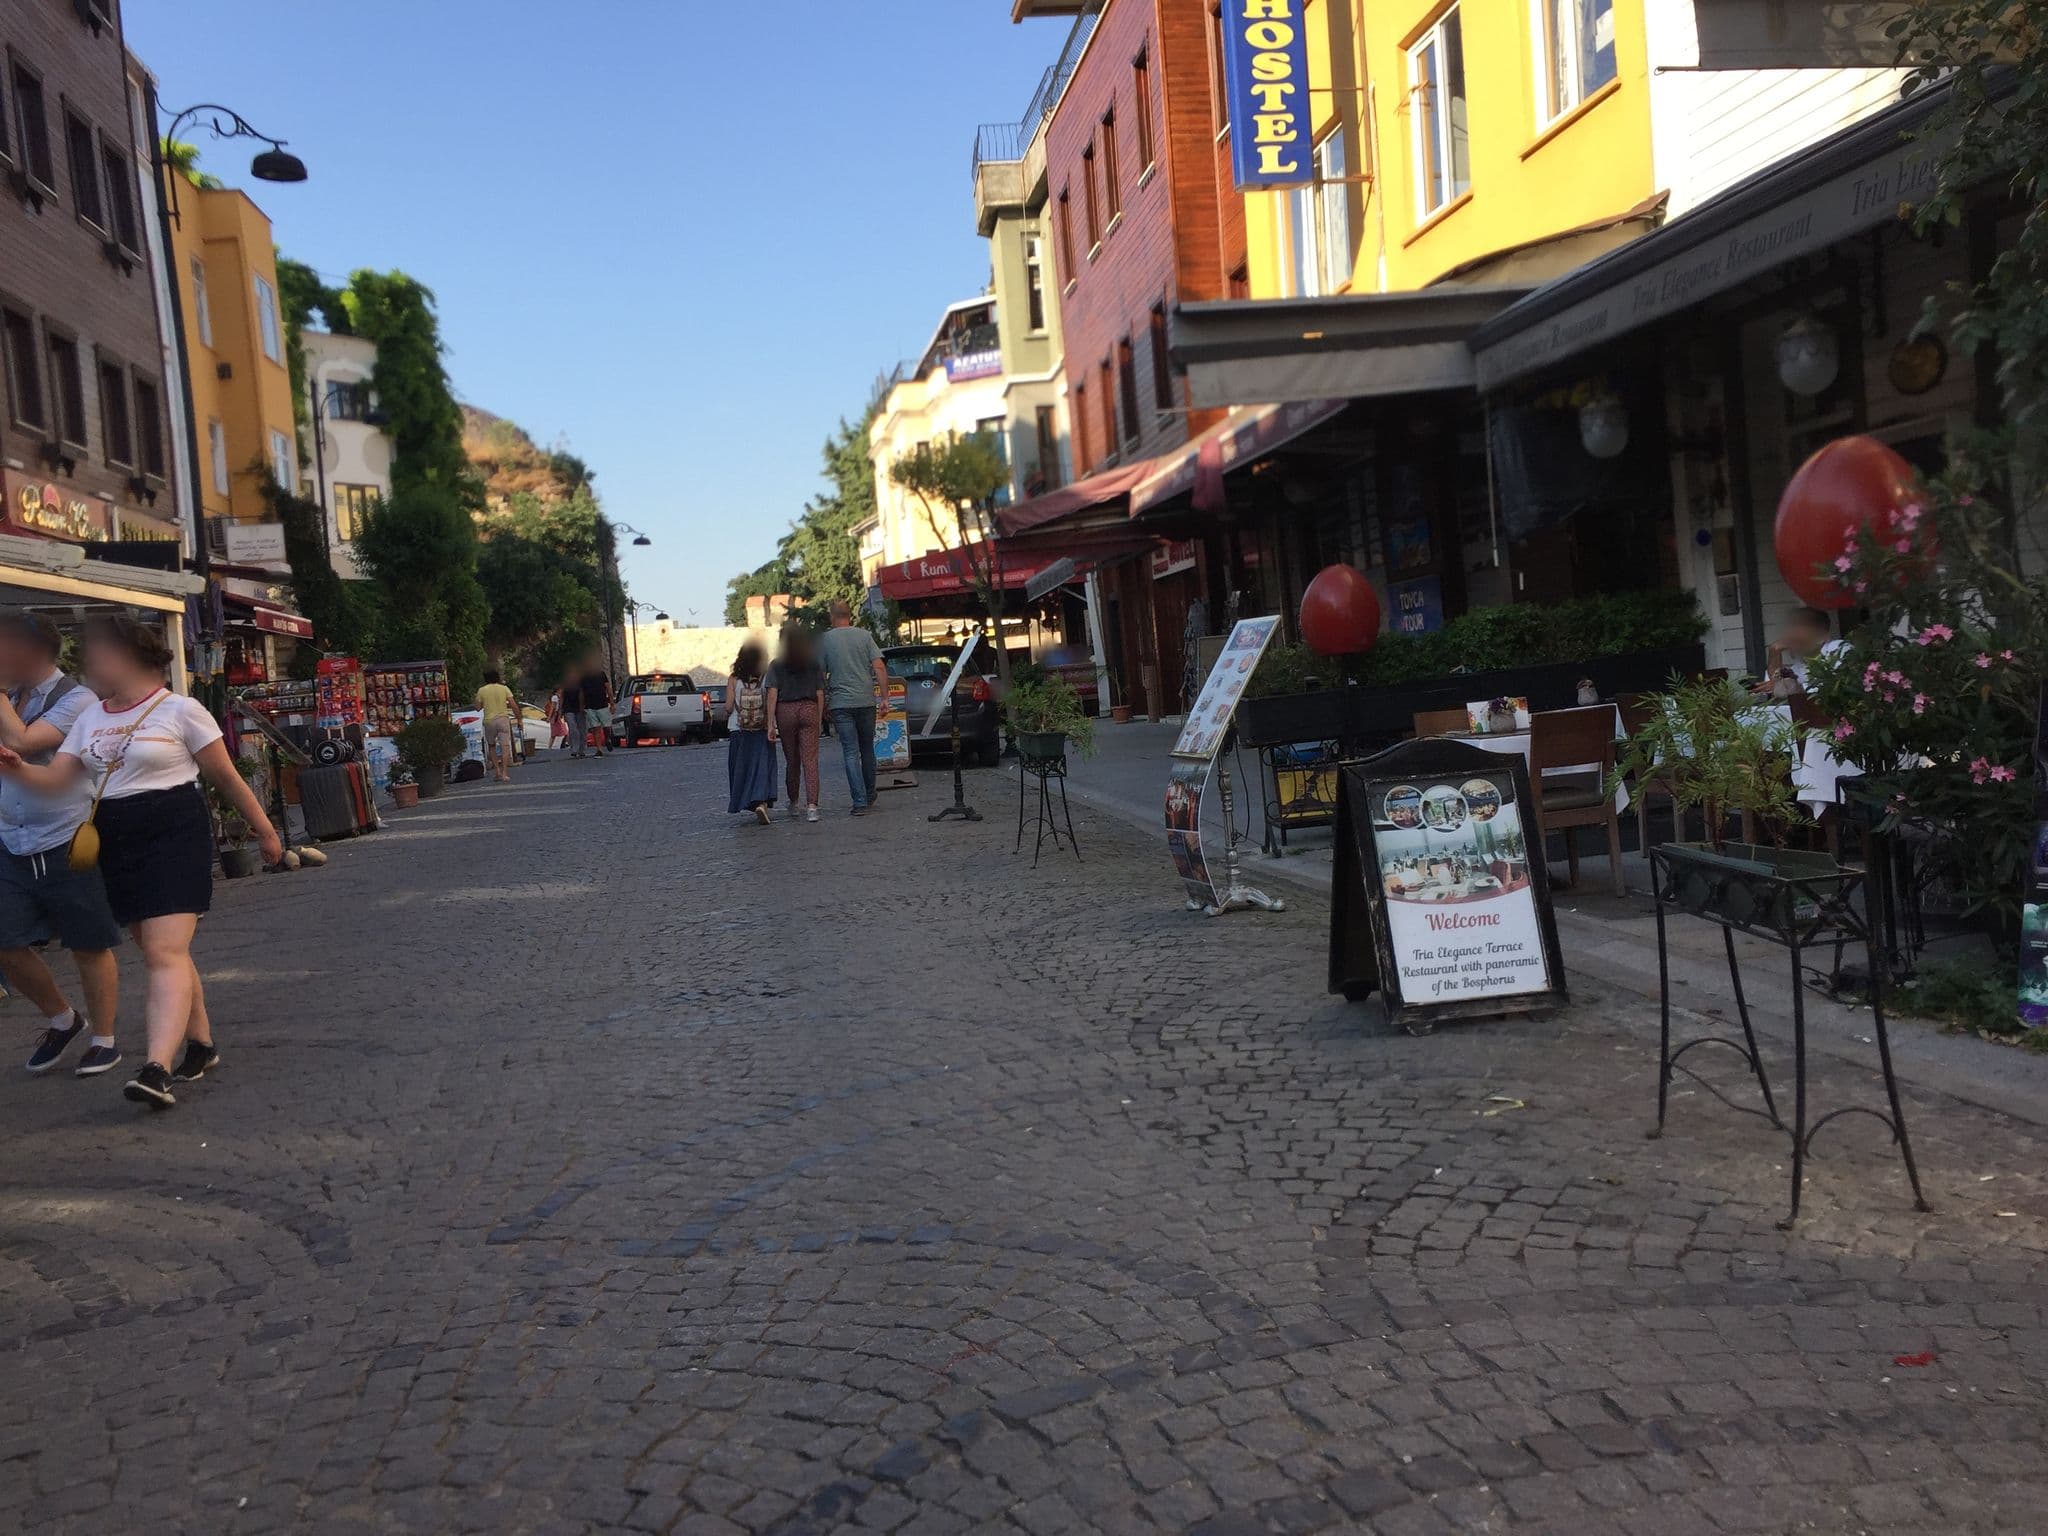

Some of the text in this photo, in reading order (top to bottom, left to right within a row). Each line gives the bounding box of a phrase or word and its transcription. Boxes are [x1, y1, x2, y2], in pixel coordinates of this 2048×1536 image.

[1242, 0, 1298, 174] HOSTEL
[1852, 171, 1889, 216] Tria
[1726, 212, 1813, 271] Restaurant
[1424, 912, 1501, 931] Welcome
[1412, 941, 1524, 962] Tria Elegance Terrace
[1401, 955, 1540, 978] Restaurant with panoramic
[1431, 974, 1516, 996] of the Bosphorus
